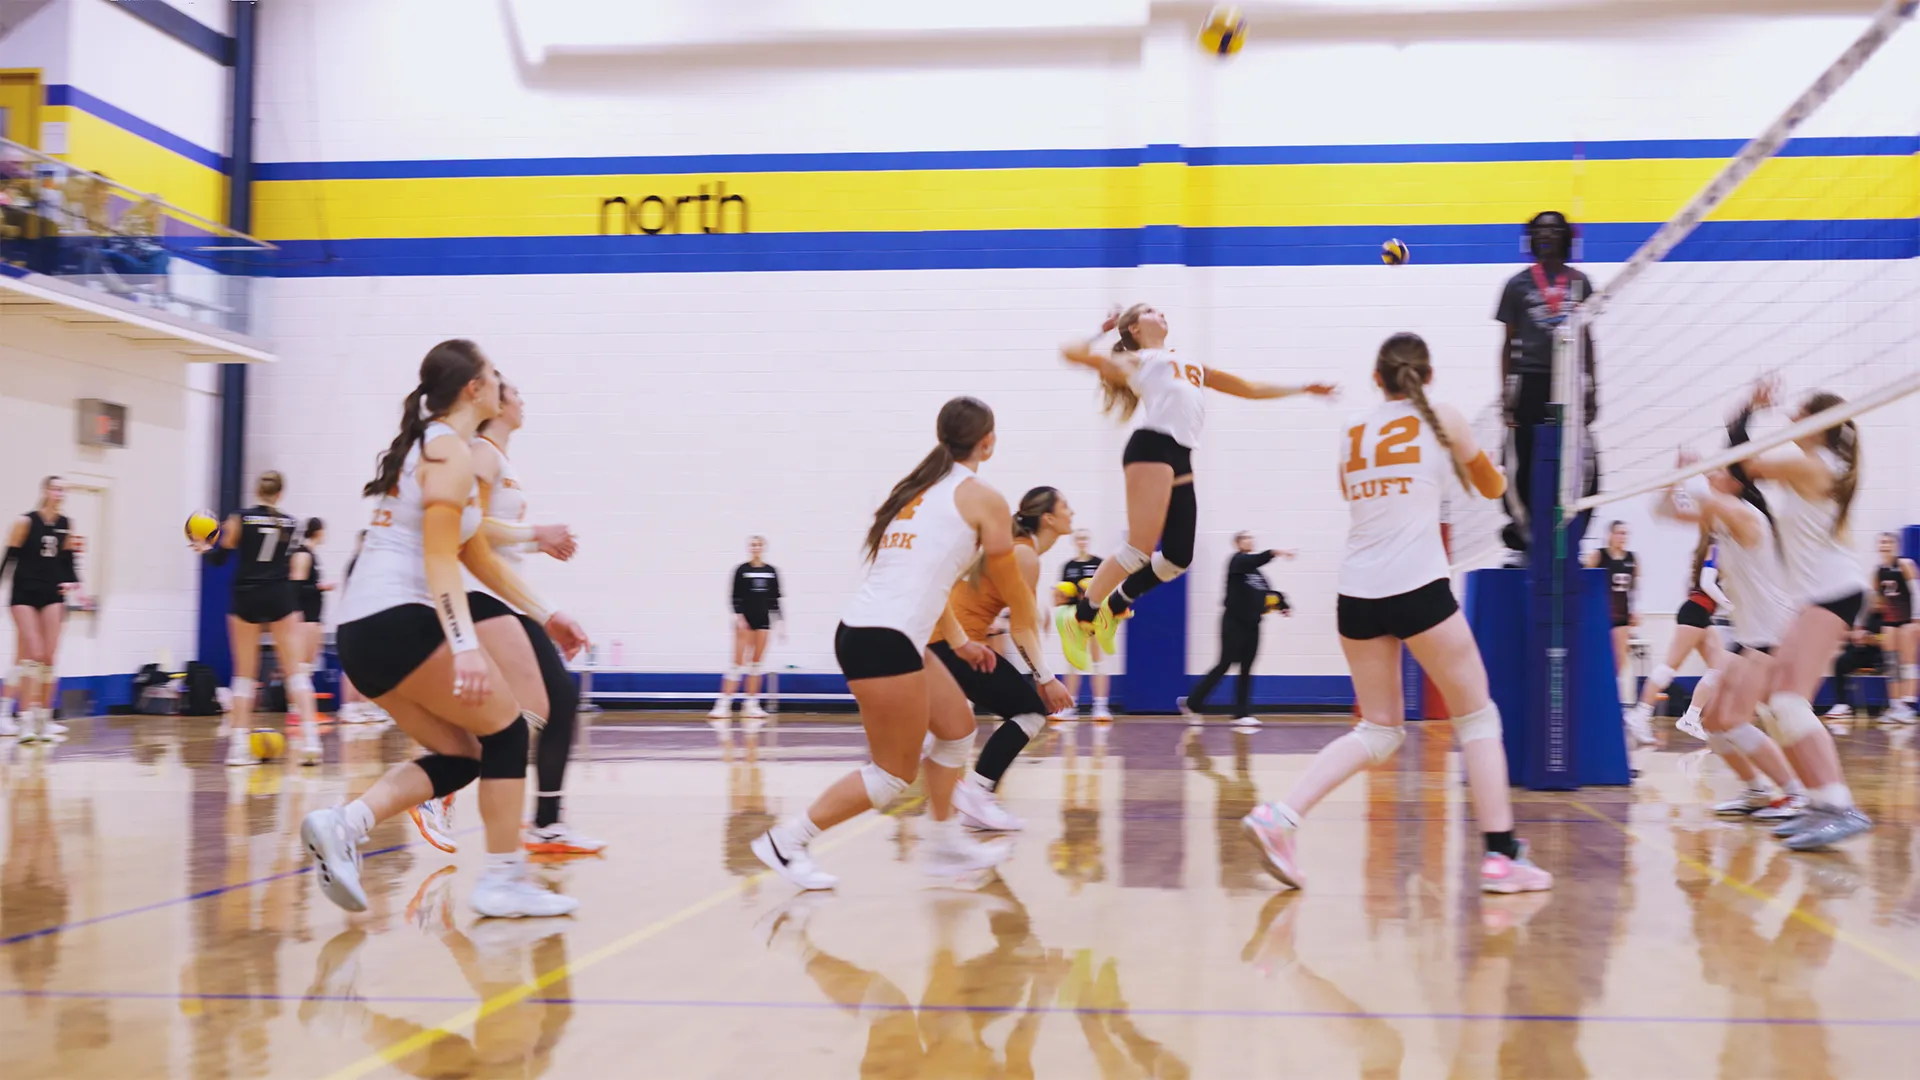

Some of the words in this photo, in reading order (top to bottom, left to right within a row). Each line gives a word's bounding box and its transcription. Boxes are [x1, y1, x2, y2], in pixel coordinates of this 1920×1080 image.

[598, 180, 748, 235] north
[1168, 361, 1202, 389] 16
[1345, 415, 1421, 474] 12
[1350, 476, 1413, 501] LUFT
[256, 527, 281, 562] 7
